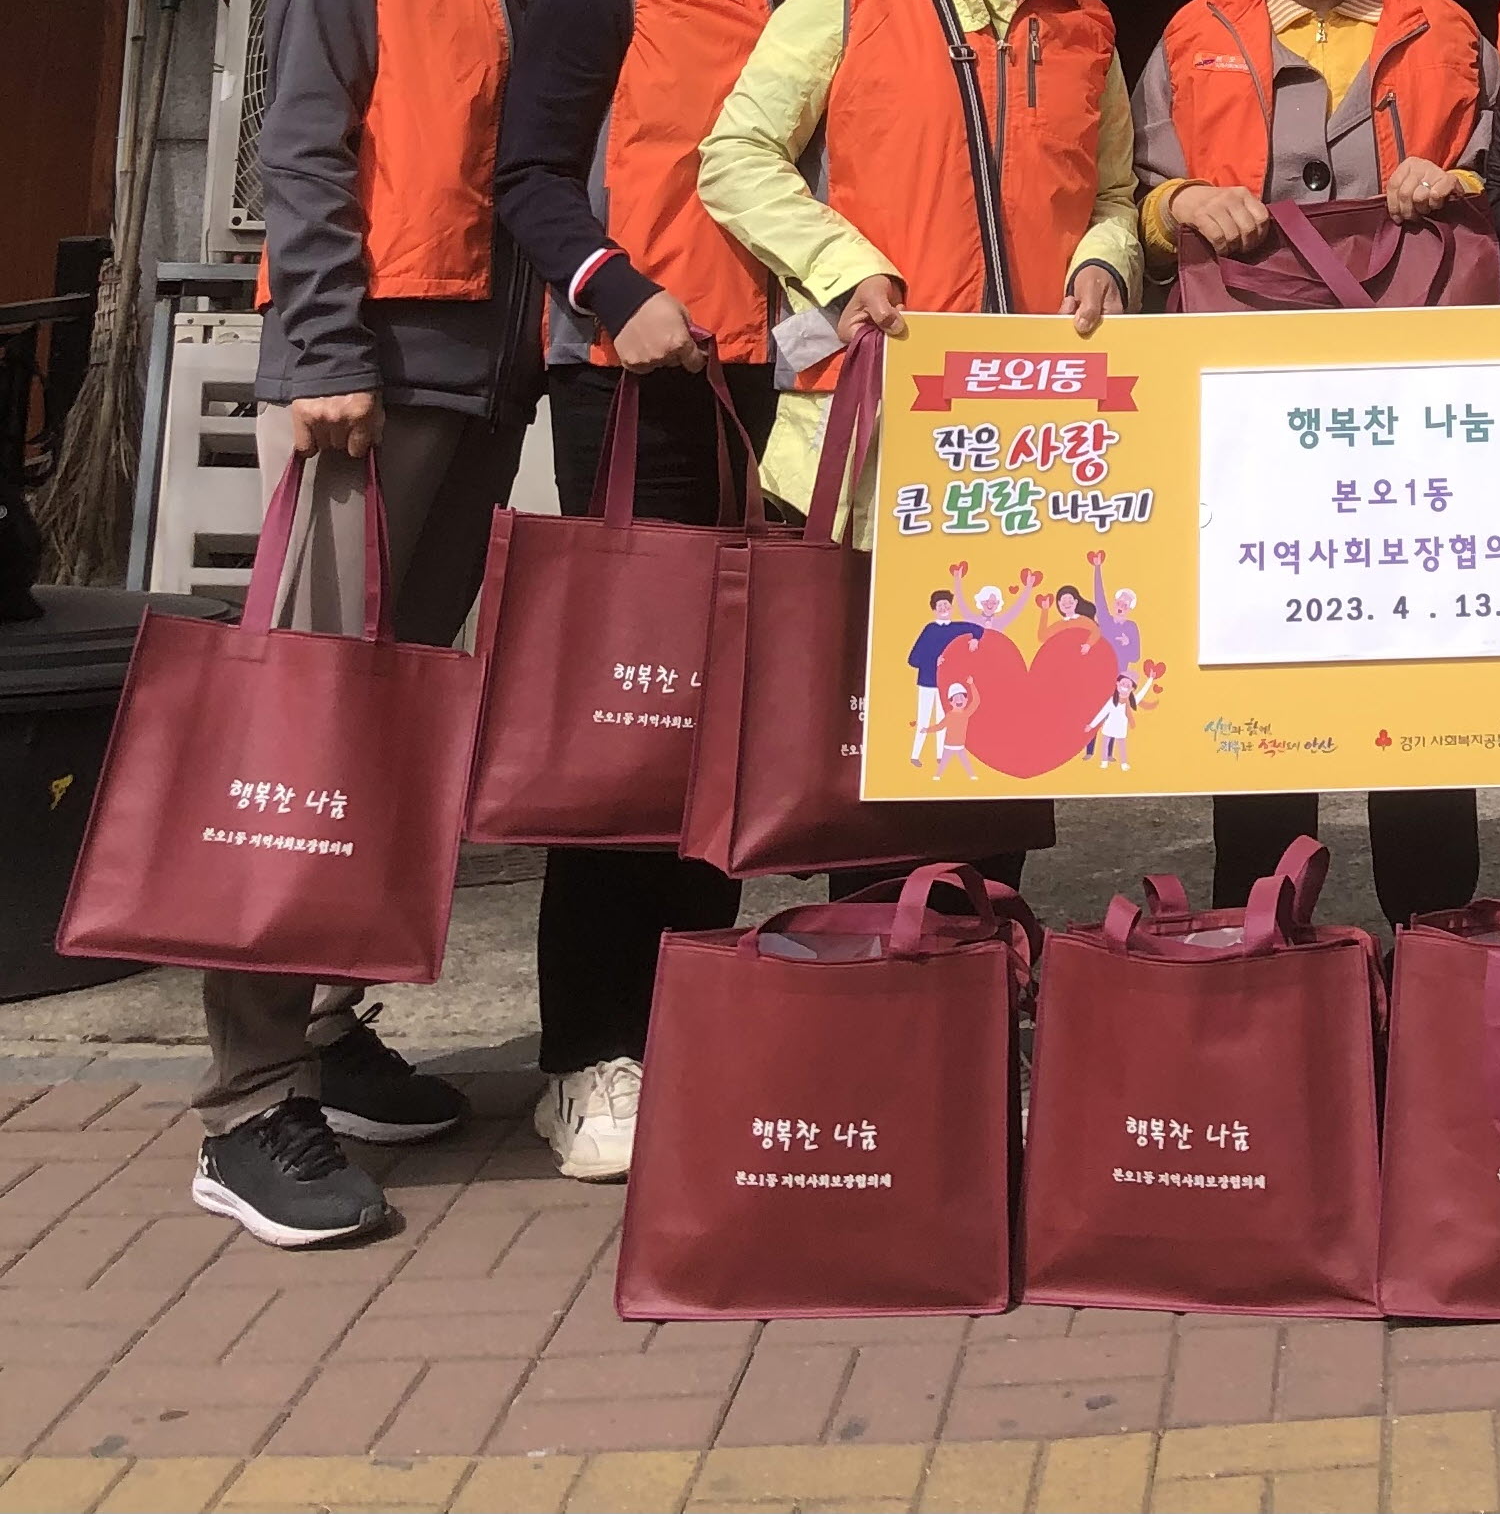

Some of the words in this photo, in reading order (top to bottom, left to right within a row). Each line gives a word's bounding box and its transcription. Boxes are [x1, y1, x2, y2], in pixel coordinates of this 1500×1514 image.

[965, 359, 1087, 394] 본오1동
[1287, 405, 1398, 449] 행복찬
[1425, 404, 1494, 443] 나눔
[934, 423, 1000, 471] 작은
[1005, 420, 1121, 486] 사랑
[893, 484, 931, 535] 큰
[942, 477, 1045, 535] 보람
[1049, 488, 1153, 533] 나누기
[1332, 477, 1453, 513] 본오1동
[1286, 597, 1374, 622] 2023.
[613, 663, 678, 693] 행복찬
[637, 713, 696, 728] 지역사회보
[1304, 737, 1338, 754] 안산
[1400, 736, 1425, 751] 경기
[229, 779, 296, 814] 행복찬
[305, 789, 348, 819] 나눔
[752, 1117, 820, 1151] 행복찬
[834, 1120, 877, 1151] 나눔
[1125, 1116, 1193, 1150] 행복찬
[1206, 1120, 1250, 1151] 나눔
